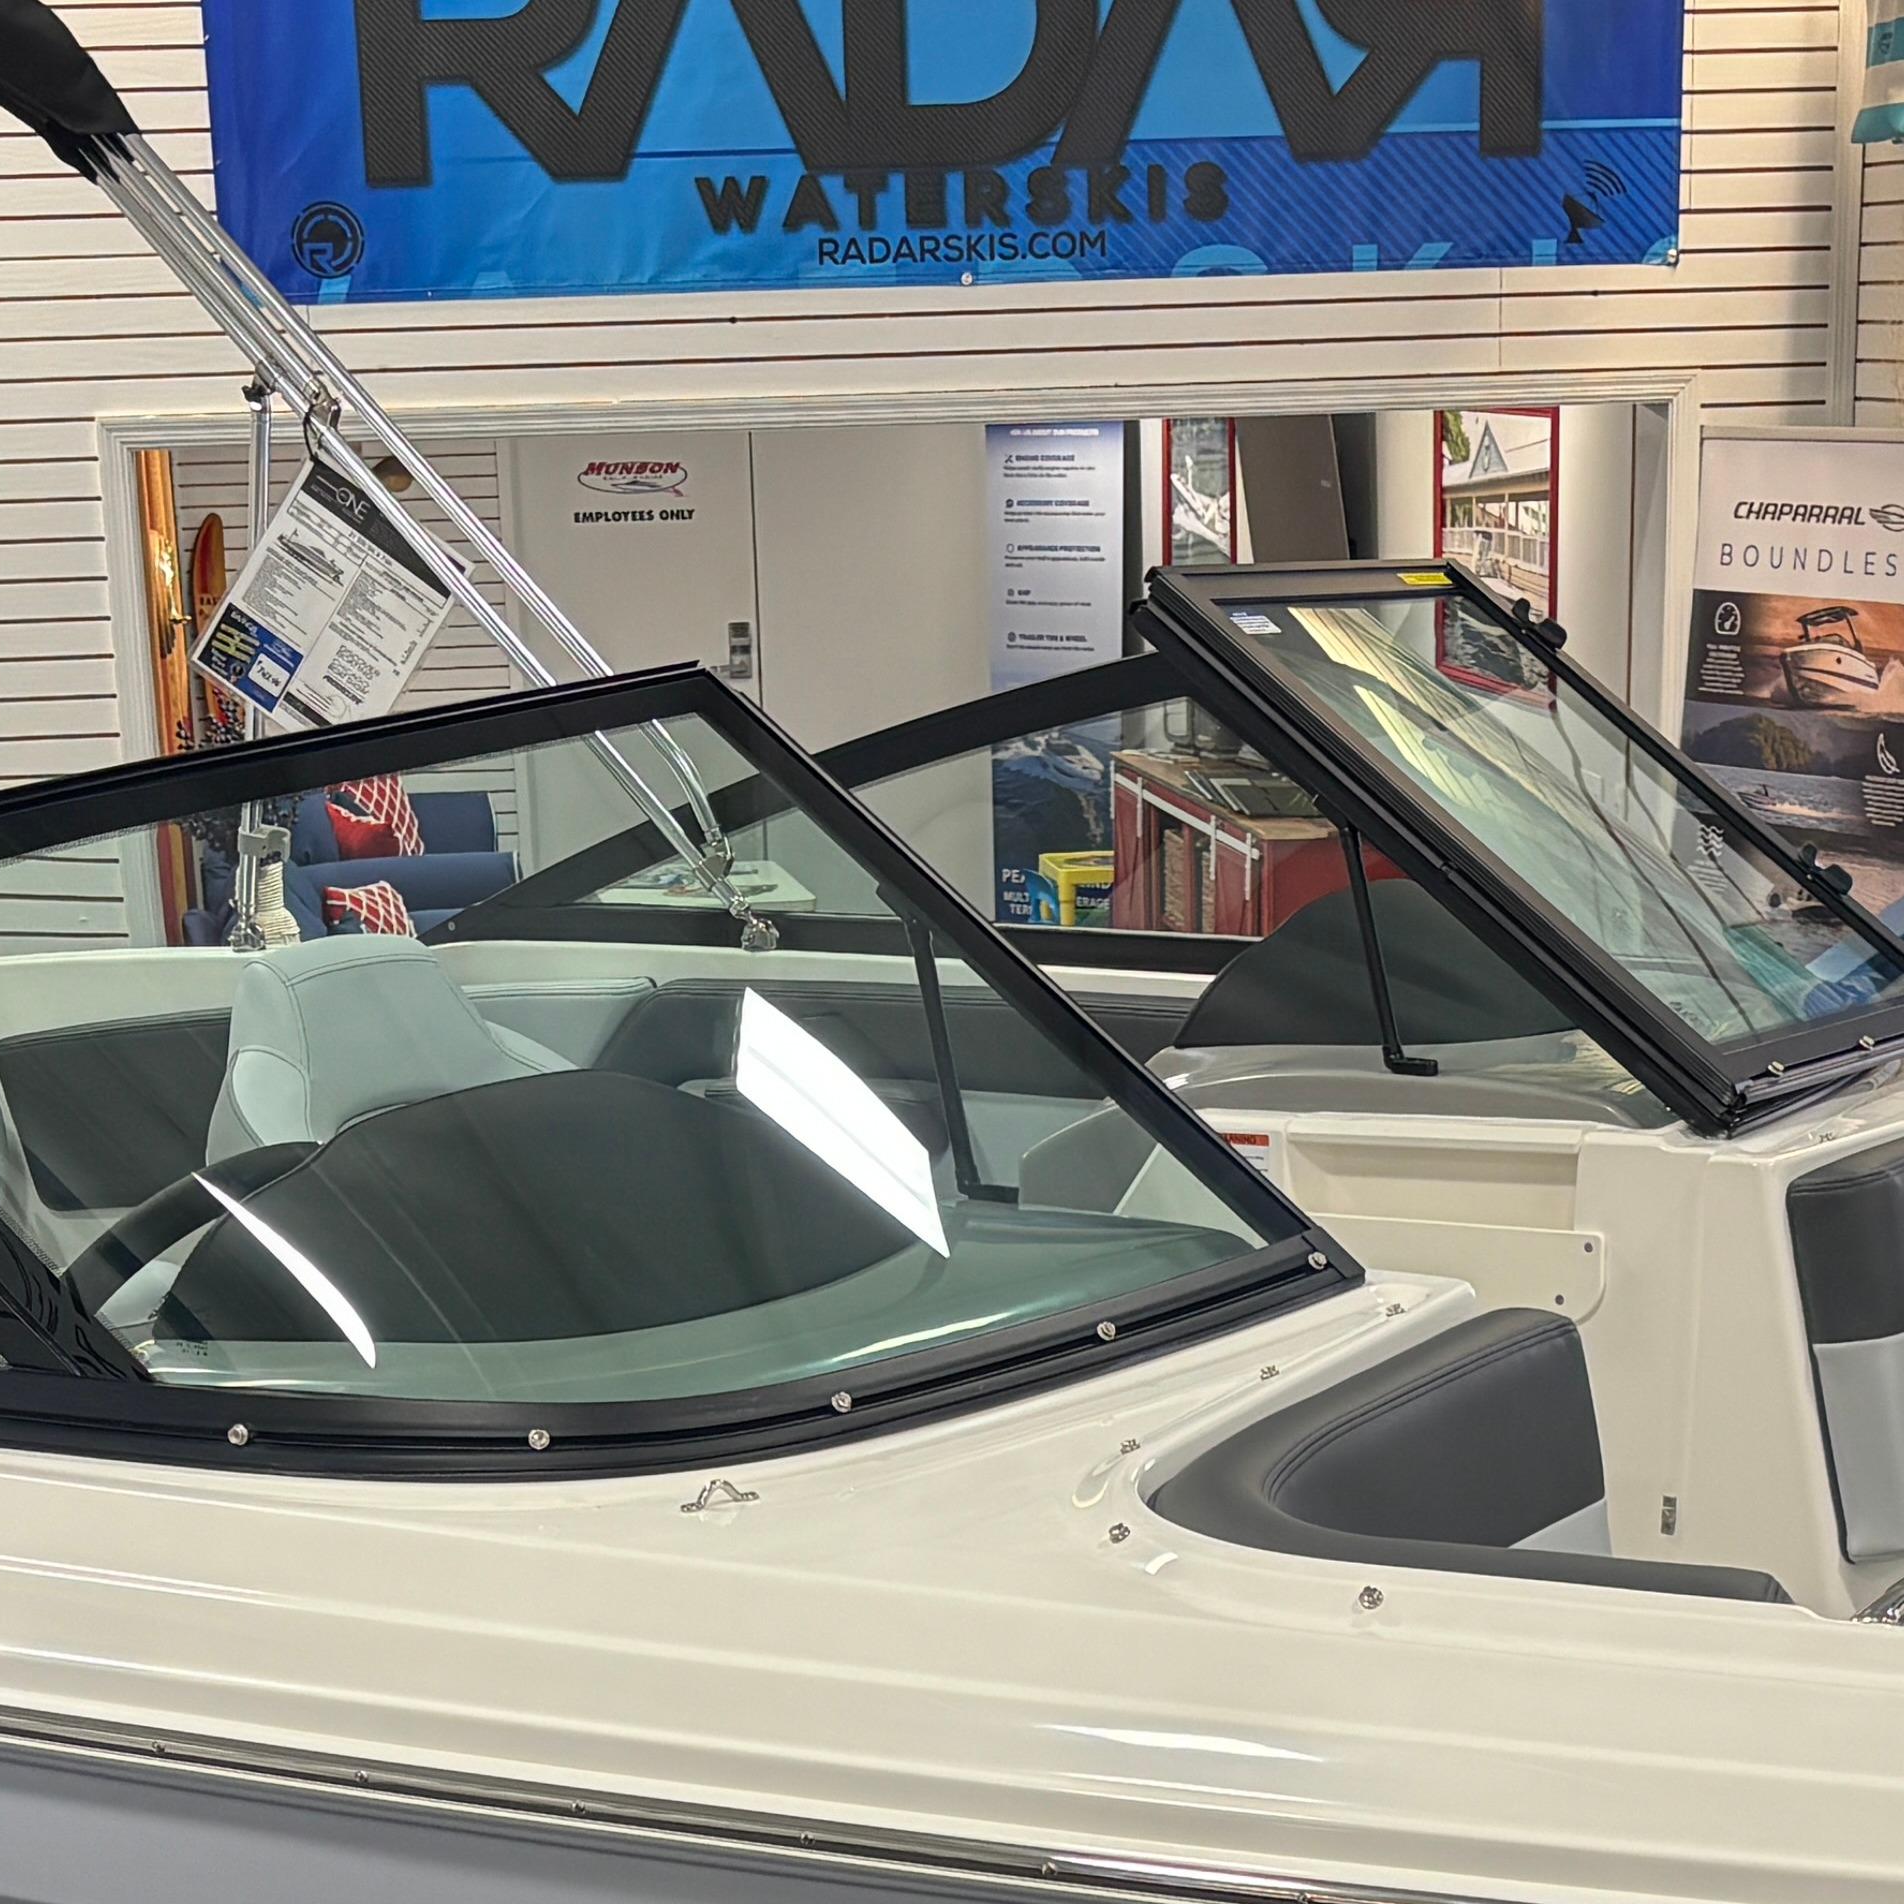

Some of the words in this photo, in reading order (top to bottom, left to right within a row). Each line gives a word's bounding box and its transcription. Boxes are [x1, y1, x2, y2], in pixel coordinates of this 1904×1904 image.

[696, 160, 1229, 234] WATERSKIS
[818, 229, 1108, 266] RADARSKIS.COM
[574, 510, 654, 523] EMPLOYEES
[659, 508, 696, 521] ONLY
[1734, 500, 1866, 526] CHAPARRAL
